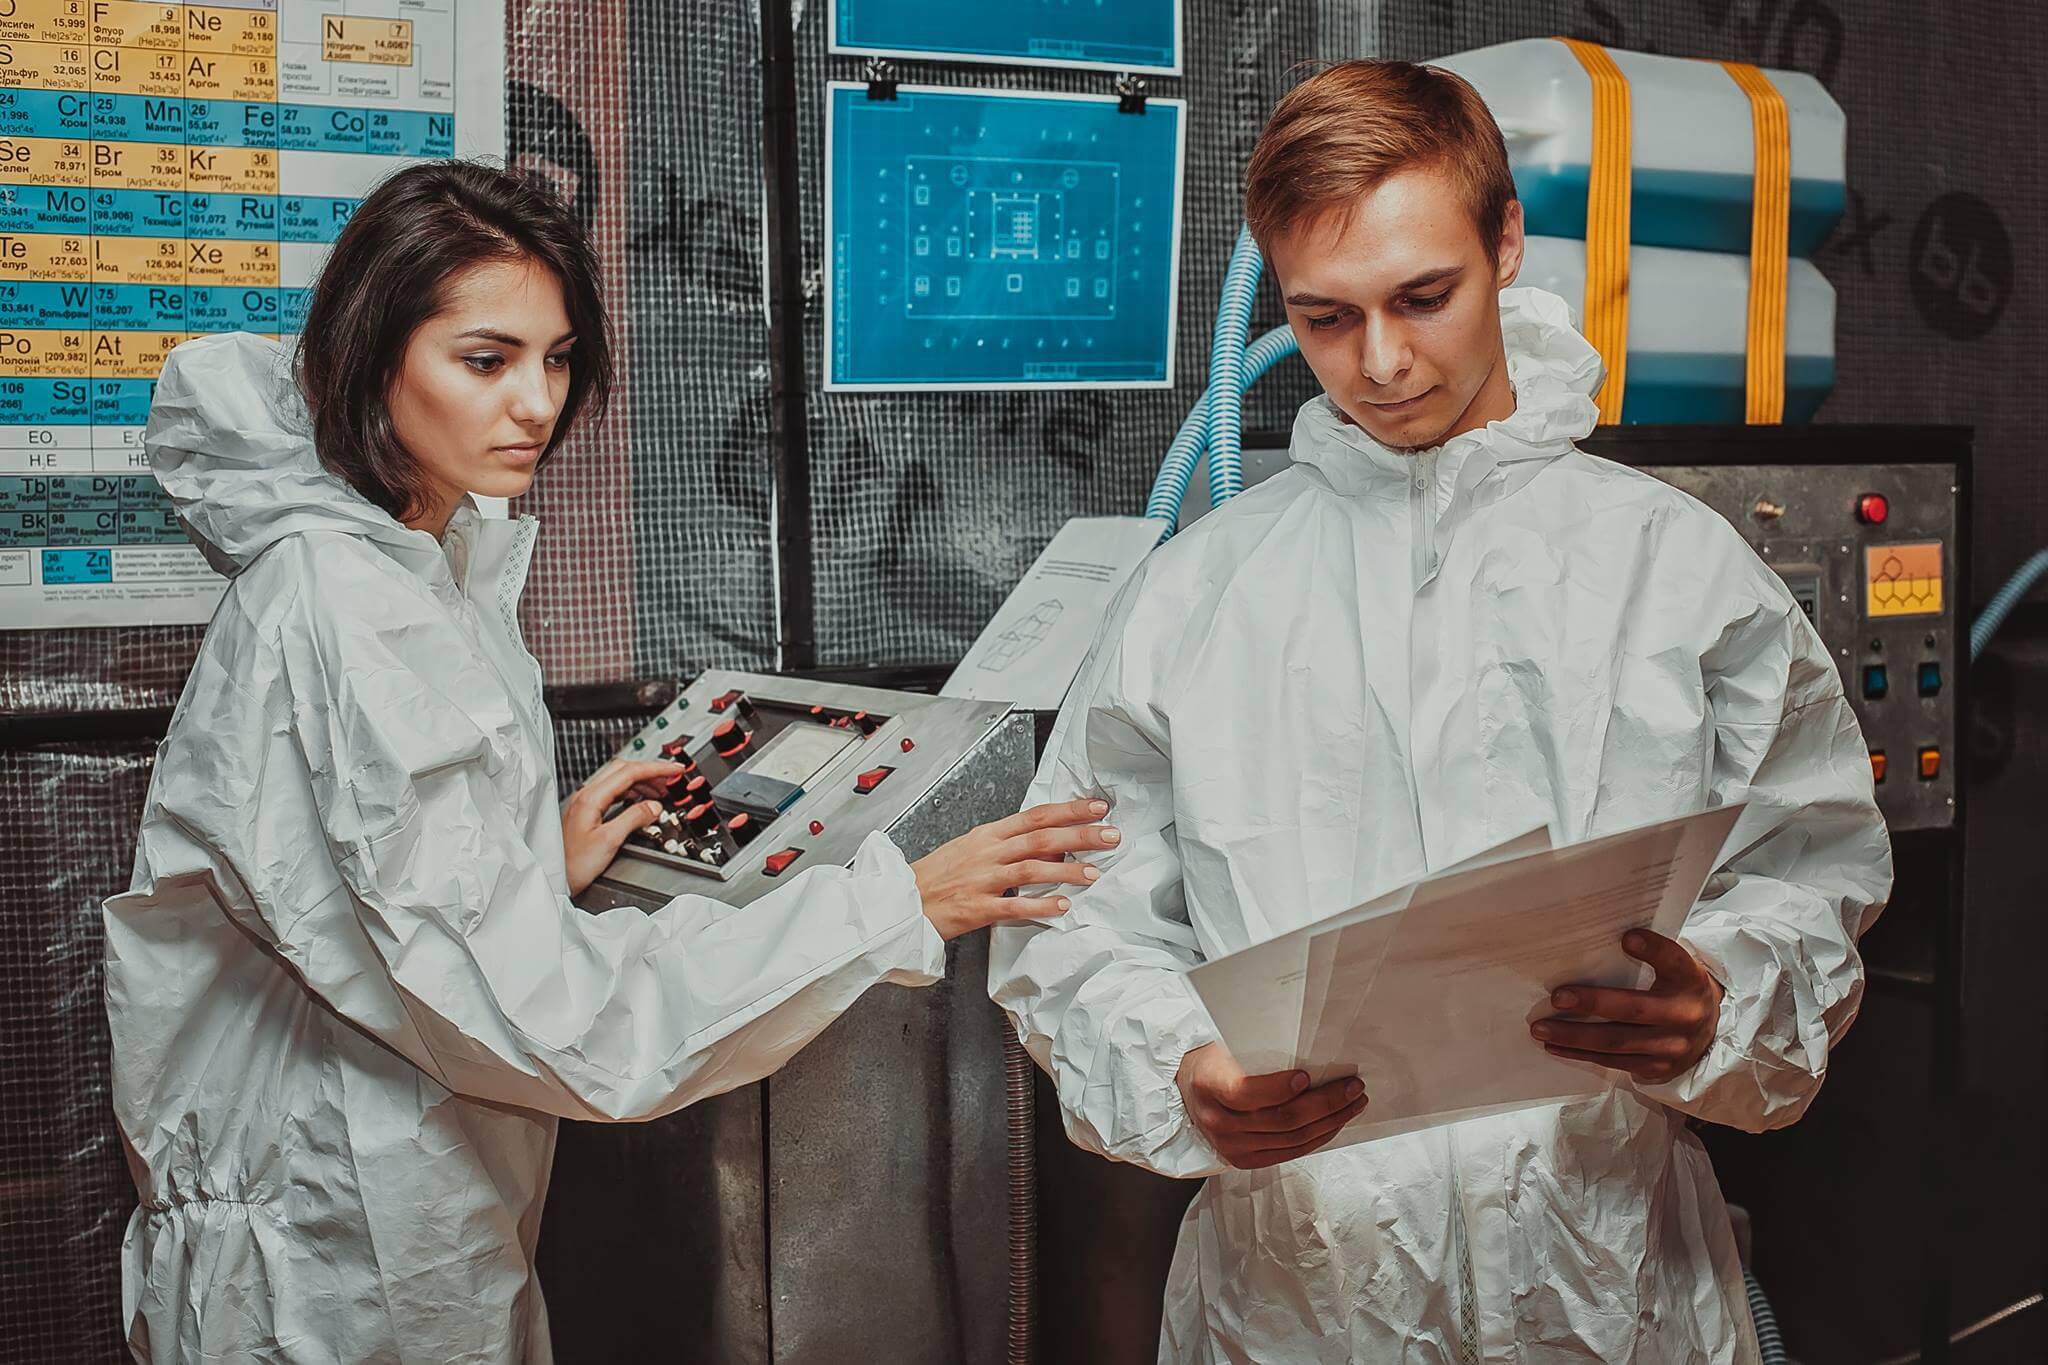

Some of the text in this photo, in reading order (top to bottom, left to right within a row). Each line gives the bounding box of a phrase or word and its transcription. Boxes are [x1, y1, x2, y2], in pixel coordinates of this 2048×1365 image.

[70, 3, 77, 13] 8
[94, 3, 108, 22] F
[166, 10, 173, 19] 9
[53, 18, 85, 28] 15,999
[189, 11, 222, 31] Ne
[252, 17, 266, 27] 10
[0, 30, 29, 39] исень
[328, 20, 343, 39] N
[396, 26, 402, 35] 7
[64, 50, 78, 61] 16
[95, 50, 119, 71] Cl
[160, 56, 173, 66] 17
[53, 66, 86, 75] 32,065
[188, 57, 216, 76] Ar
[252, 63, 266, 72] 18
[0, 76, 21, 86] ірка
[95, 73, 121, 83] Хлор
[149, 72, 180, 81] 35,453
[0, 94, 14, 104] 24
[97, 99, 113, 109] 25
[58, 95, 88, 116] Cr
[192, 104, 206, 115] 26
[0, 111, 28, 120] 1,996
[145, 101, 181, 122] Mn
[245, 106, 274, 126] Fe
[284, 110, 298, 120] 27
[60, 118, 87, 128] Хром
[332, 111, 364, 132] Co
[374, 115, 387, 125] 28
[429, 117, 451, 137] Ni
[0, 141, 30, 162] Se
[64, 145, 79, 155] 34
[95, 145, 122, 165] Br
[160, 150, 175, 160] 35
[190, 150, 216, 170] Kr
[254, 155, 268, 165] 36
[54, 161, 85, 171] 78,971
[151, 166, 181, 175] 79,904
[94, 168, 122, 178] Бром
[48, 190, 85, 212] Mo
[97, 195, 113, 205] 43
[192, 198, 207, 208] 44
[154, 195, 182, 216] Tc
[242, 198, 274, 219] Ru
[286, 201, 300, 212] 45
[0, 208, 28, 216] 5,941
[0, 237, 26, 257] Te
[65, 241, 79, 251] 52
[161, 244, 175, 254] 53
[190, 244, 222, 264] Xe
[255, 247, 268, 257] 54
[50, 257, 87, 266] 127,603
[0, 287, 14, 297] 74
[61, 287, 88, 307] W
[98, 289, 114, 299] 75
[193, 291, 208, 302] 76
[150, 289, 182, 310] Re
[243, 291, 276, 312] Os
[0, 304, 34, 312] 83,841
[0, 333, 31, 354] Po
[64, 336, 79, 347] 84
[95, 335, 121, 355] At
[162, 338, 176, 348] 85
[1, 383, 24, 393] 106
[53, 381, 86, 404] Sg
[99, 384, 121, 394] 107
[0, 400, 22, 410] 266]
[21, 478, 45, 494] Tb
[93, 478, 117, 494] Dy
[22, 514, 45, 528] Bk
[52, 515, 64, 523] 98
[97, 513, 118, 528] Cf
[123, 514, 136, 523] 99
[165, 514, 176, 525] E
[86, 552, 108, 567] Zn
